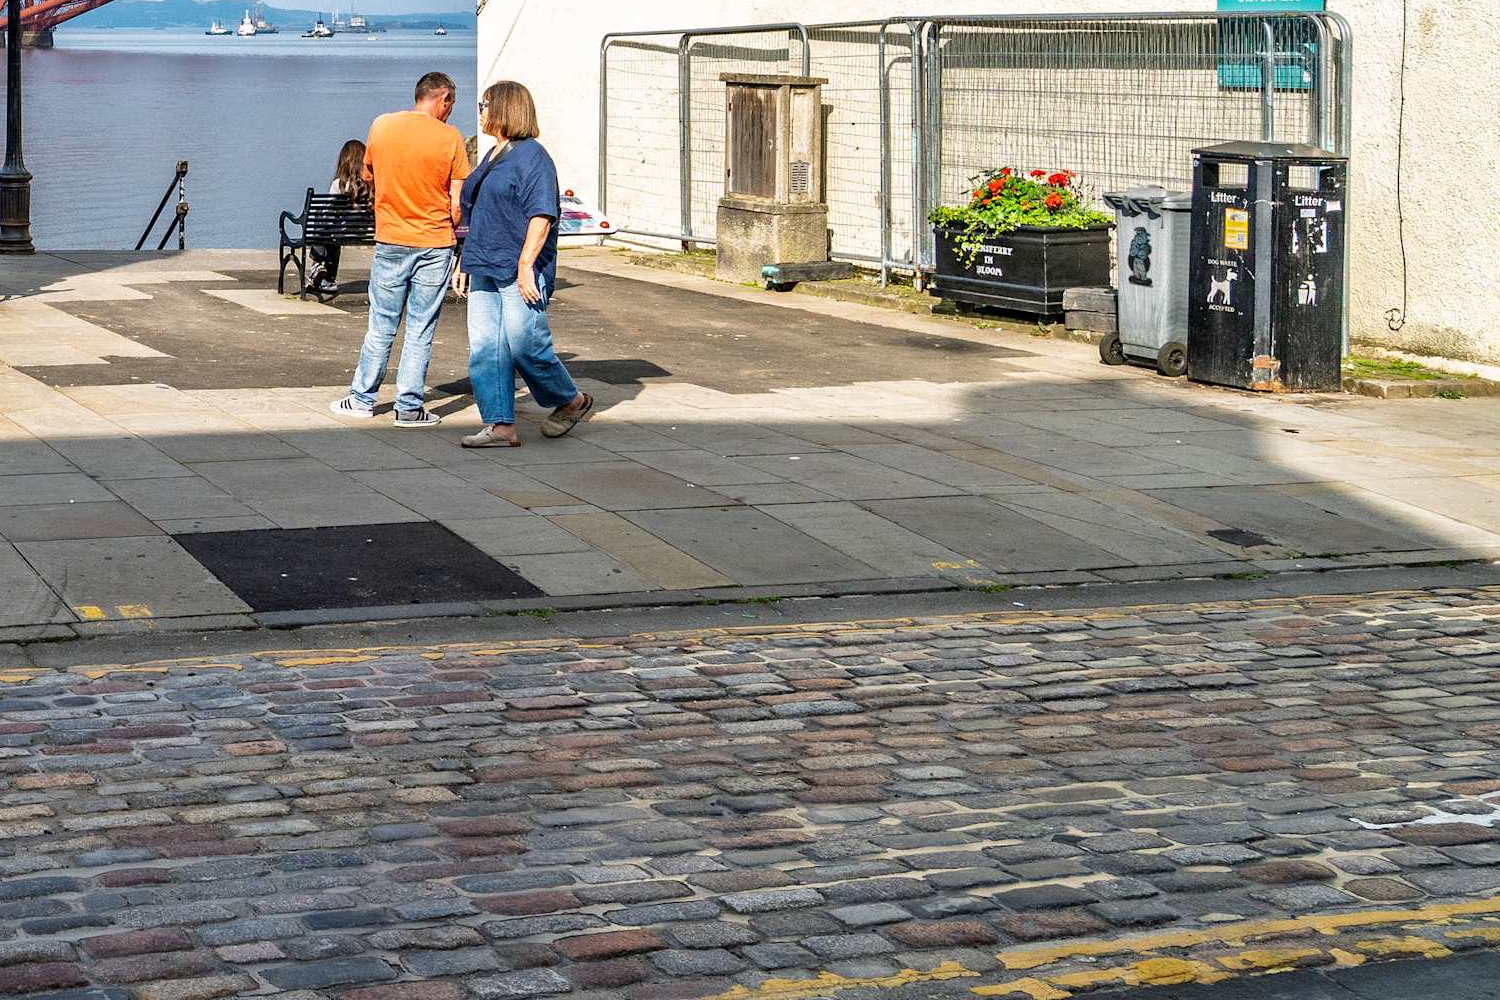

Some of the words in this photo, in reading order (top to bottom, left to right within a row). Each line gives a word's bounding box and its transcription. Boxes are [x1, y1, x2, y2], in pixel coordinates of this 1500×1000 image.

[1210, 191, 1238, 204] Litter
[1294, 195, 1323, 207] Litter
[976, 265, 1003, 276] BLOOM
